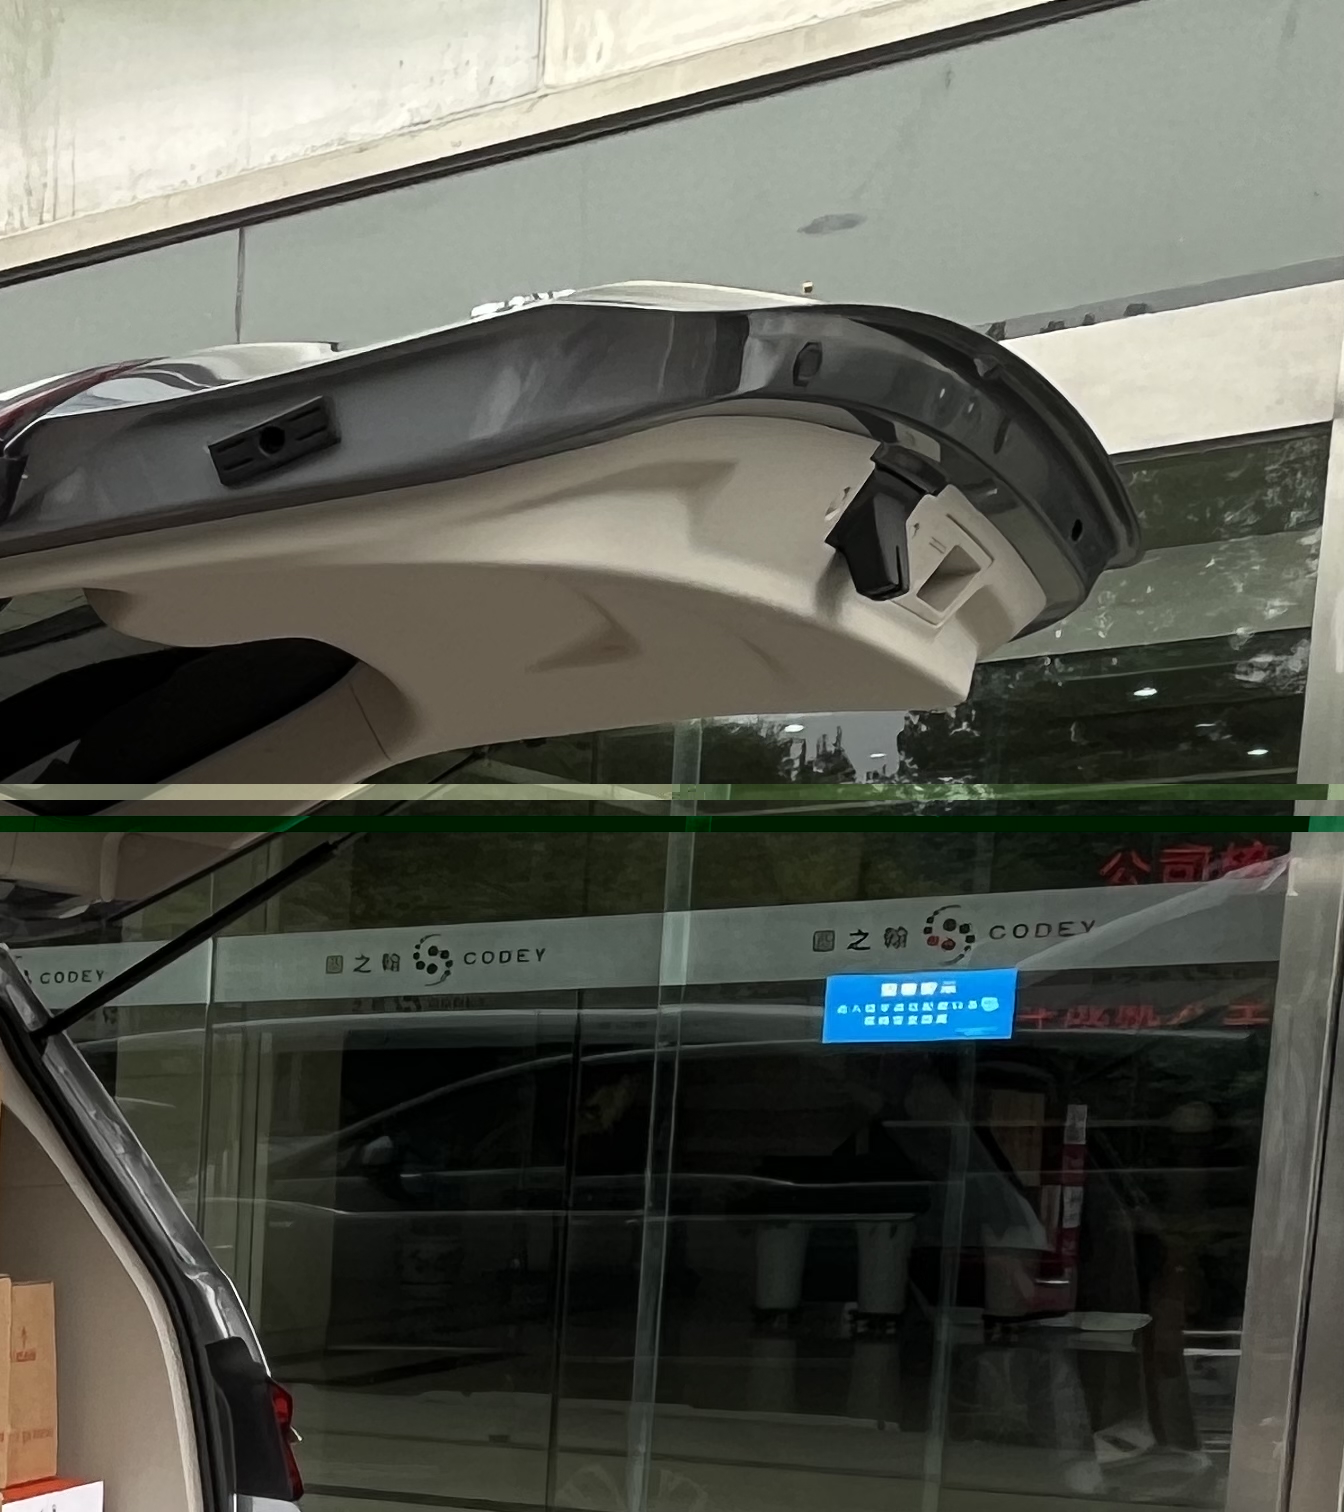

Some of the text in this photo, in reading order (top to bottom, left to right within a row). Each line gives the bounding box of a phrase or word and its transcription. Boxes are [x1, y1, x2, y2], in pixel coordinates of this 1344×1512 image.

[988, 919, 1097, 941] CODEY
[463, 947, 547, 966] CODEY
[39, 968, 107, 986] CODEY
